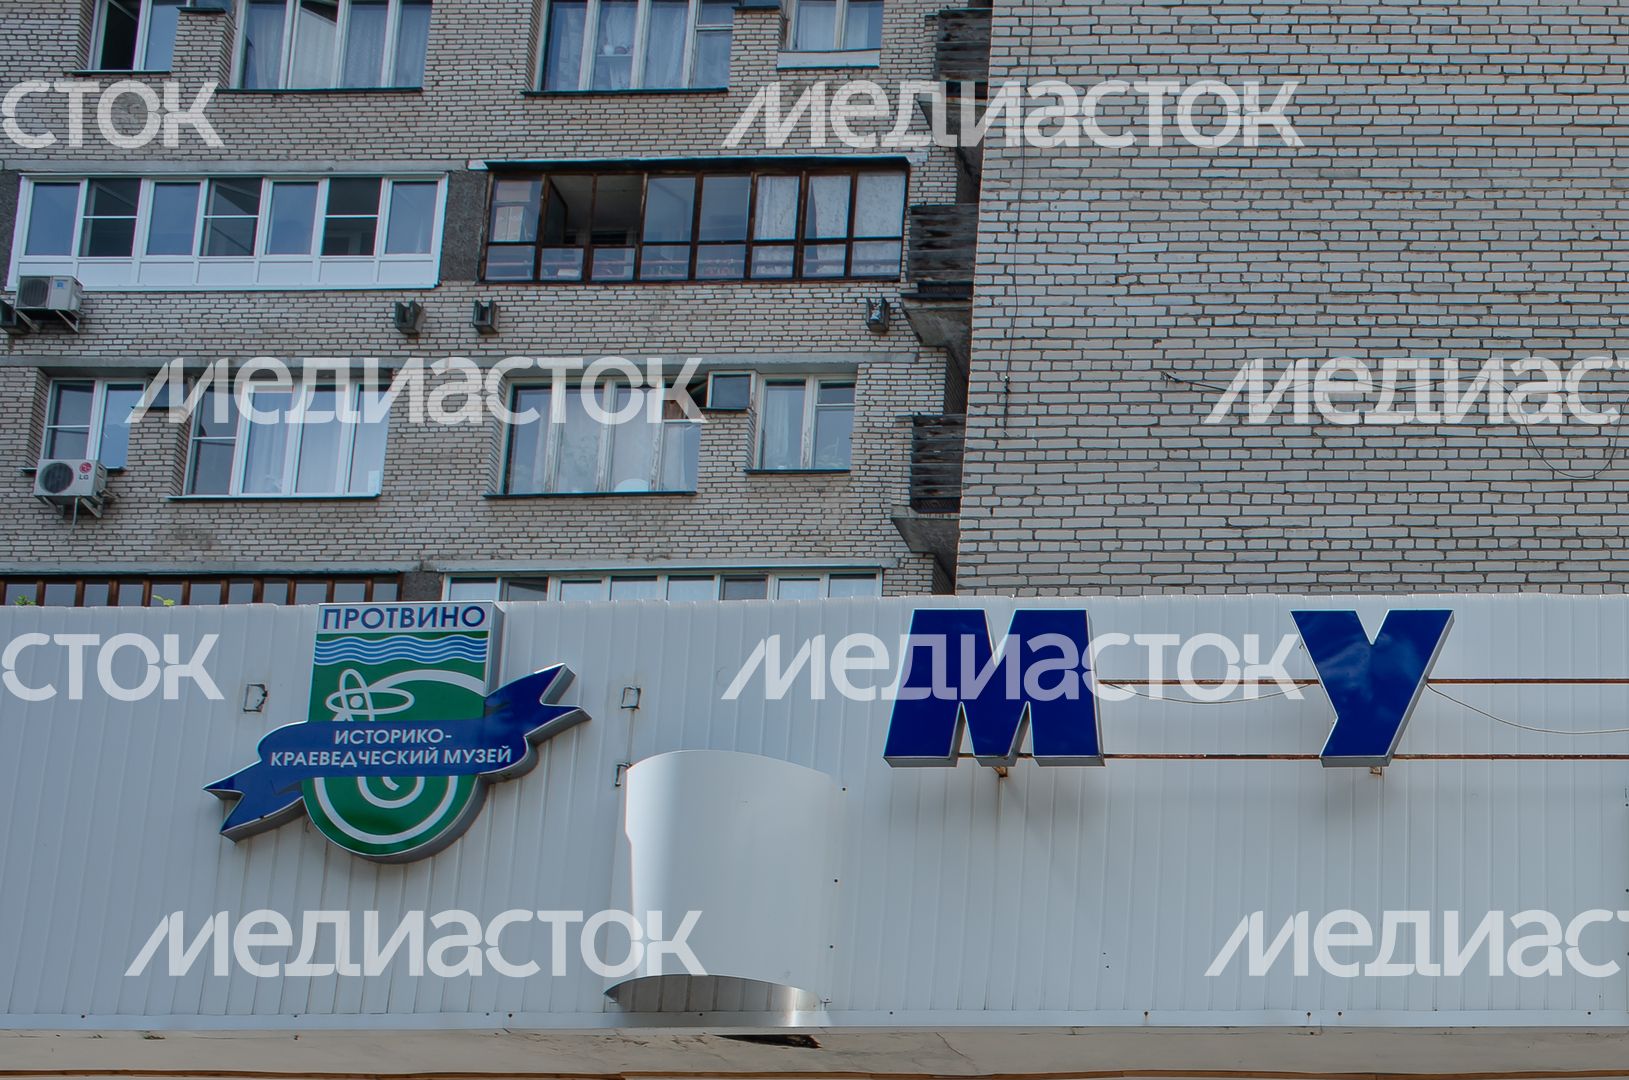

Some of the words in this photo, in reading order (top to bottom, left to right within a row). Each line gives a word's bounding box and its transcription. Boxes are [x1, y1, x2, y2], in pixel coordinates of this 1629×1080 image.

[323, 605, 486, 629] ПРОТВИНО
[334, 728, 452, 745] ИСТОРИКО-
[270, 747, 440, 768] КРАЕВЕДЧЕСКИЙ
[443, 745, 512, 764] МУЗЕЙ
